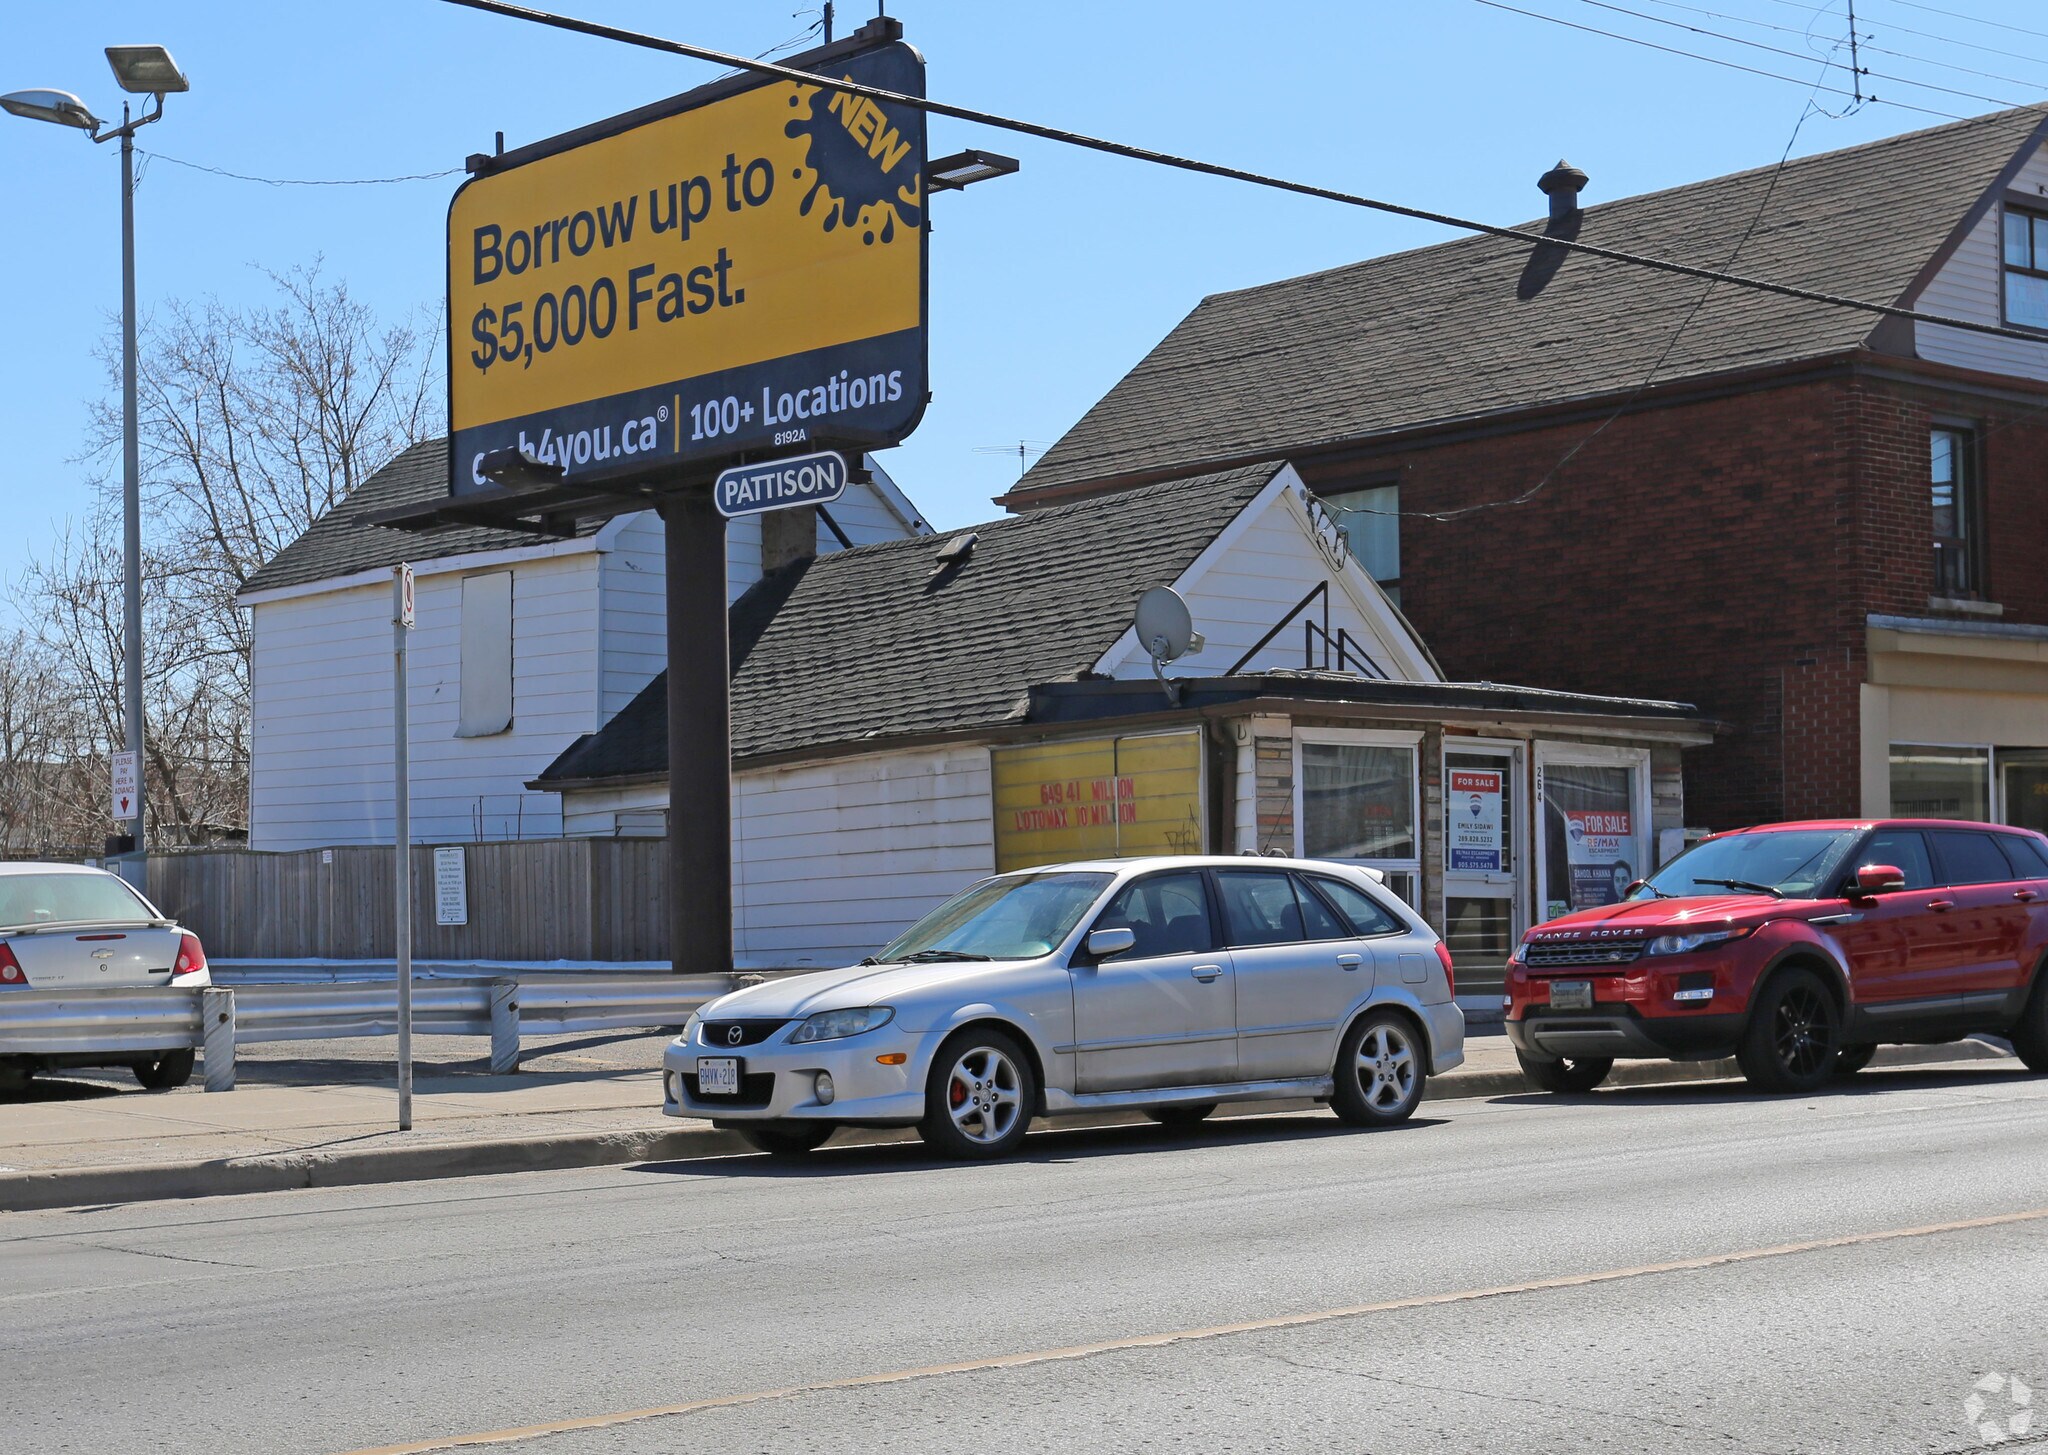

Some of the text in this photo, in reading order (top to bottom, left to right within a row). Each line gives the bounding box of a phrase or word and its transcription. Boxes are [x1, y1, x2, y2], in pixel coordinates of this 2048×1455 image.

[827, 74, 912, 174] NEW
[473, 152, 775, 286] Borrow up to
[471, 247, 745, 375] $5,000 Fast.
[690, 395, 755, 441] 100+
[763, 369, 902, 426] Locations
[774, 428, 806, 446] 8192A
[724, 462, 836, 506] PATTISON
[1066, 780, 1081, 802] 41
[1457, 777, 1494, 787] FOR SALE
[1457, 822, 1473, 830] EMILY
[1584, 815, 1628, 833] FOR SALE
[1587, 838, 1620, 848] RE/MAX
[1535, 928, 1644, 940] RANGE ROVER
